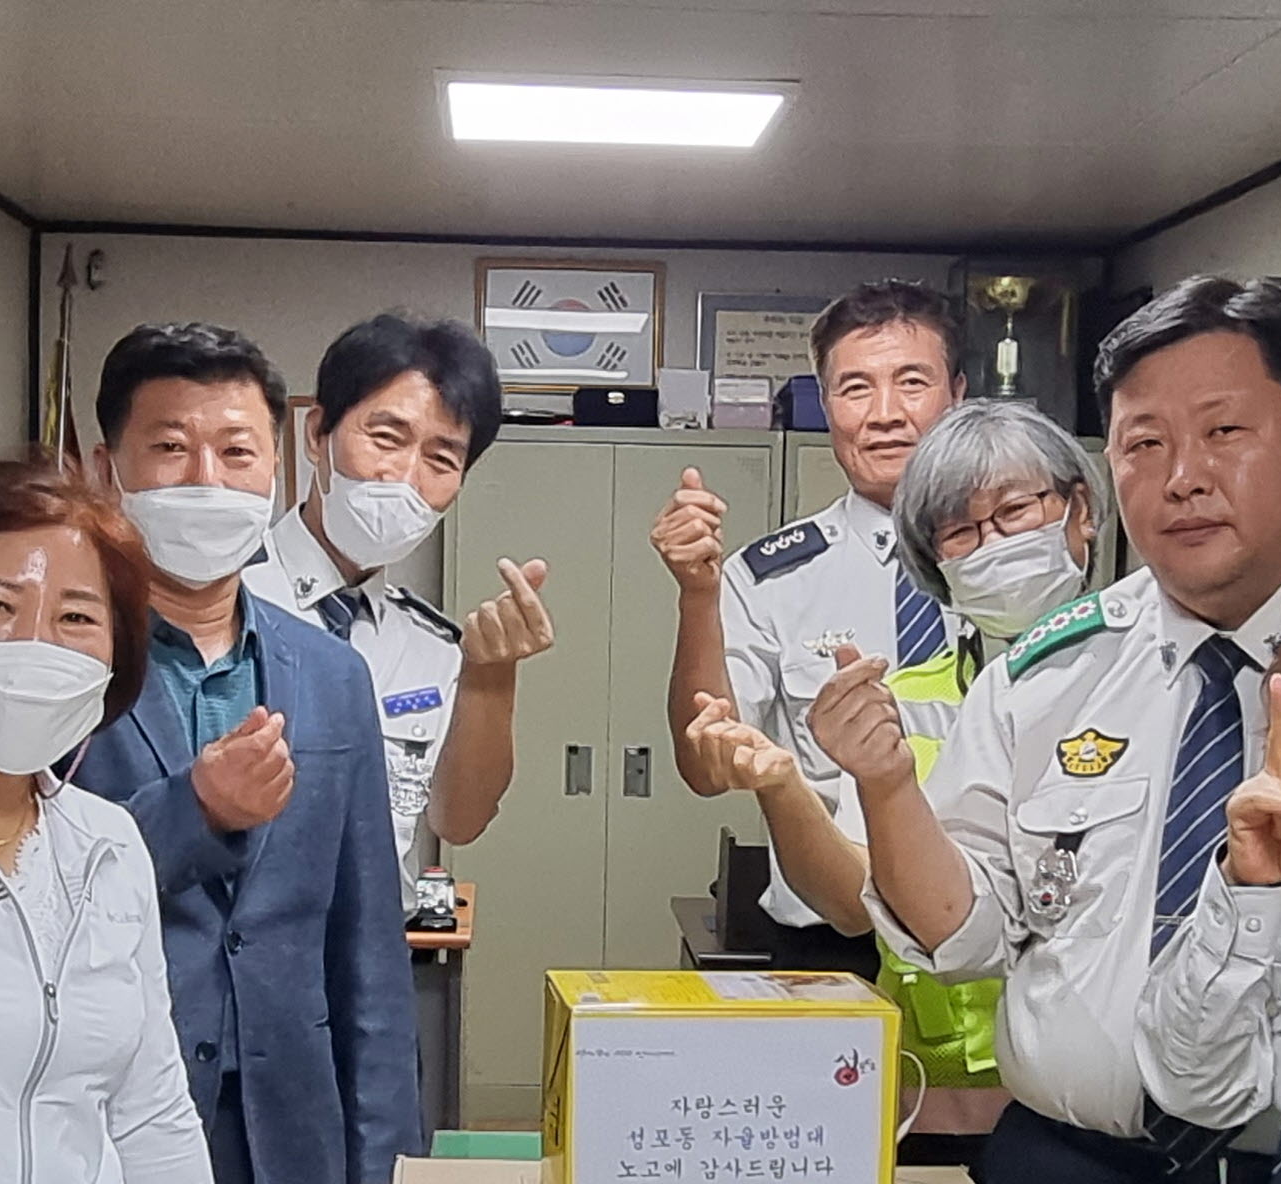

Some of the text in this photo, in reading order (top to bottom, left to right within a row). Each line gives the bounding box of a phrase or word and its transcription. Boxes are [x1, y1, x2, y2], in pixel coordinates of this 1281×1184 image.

[671, 1094, 788, 1120] 자랑스러운
[630, 1125, 825, 1151] 성포동 자율방범대
[616, 1155, 834, 1180] 노고에 감사드립니다
